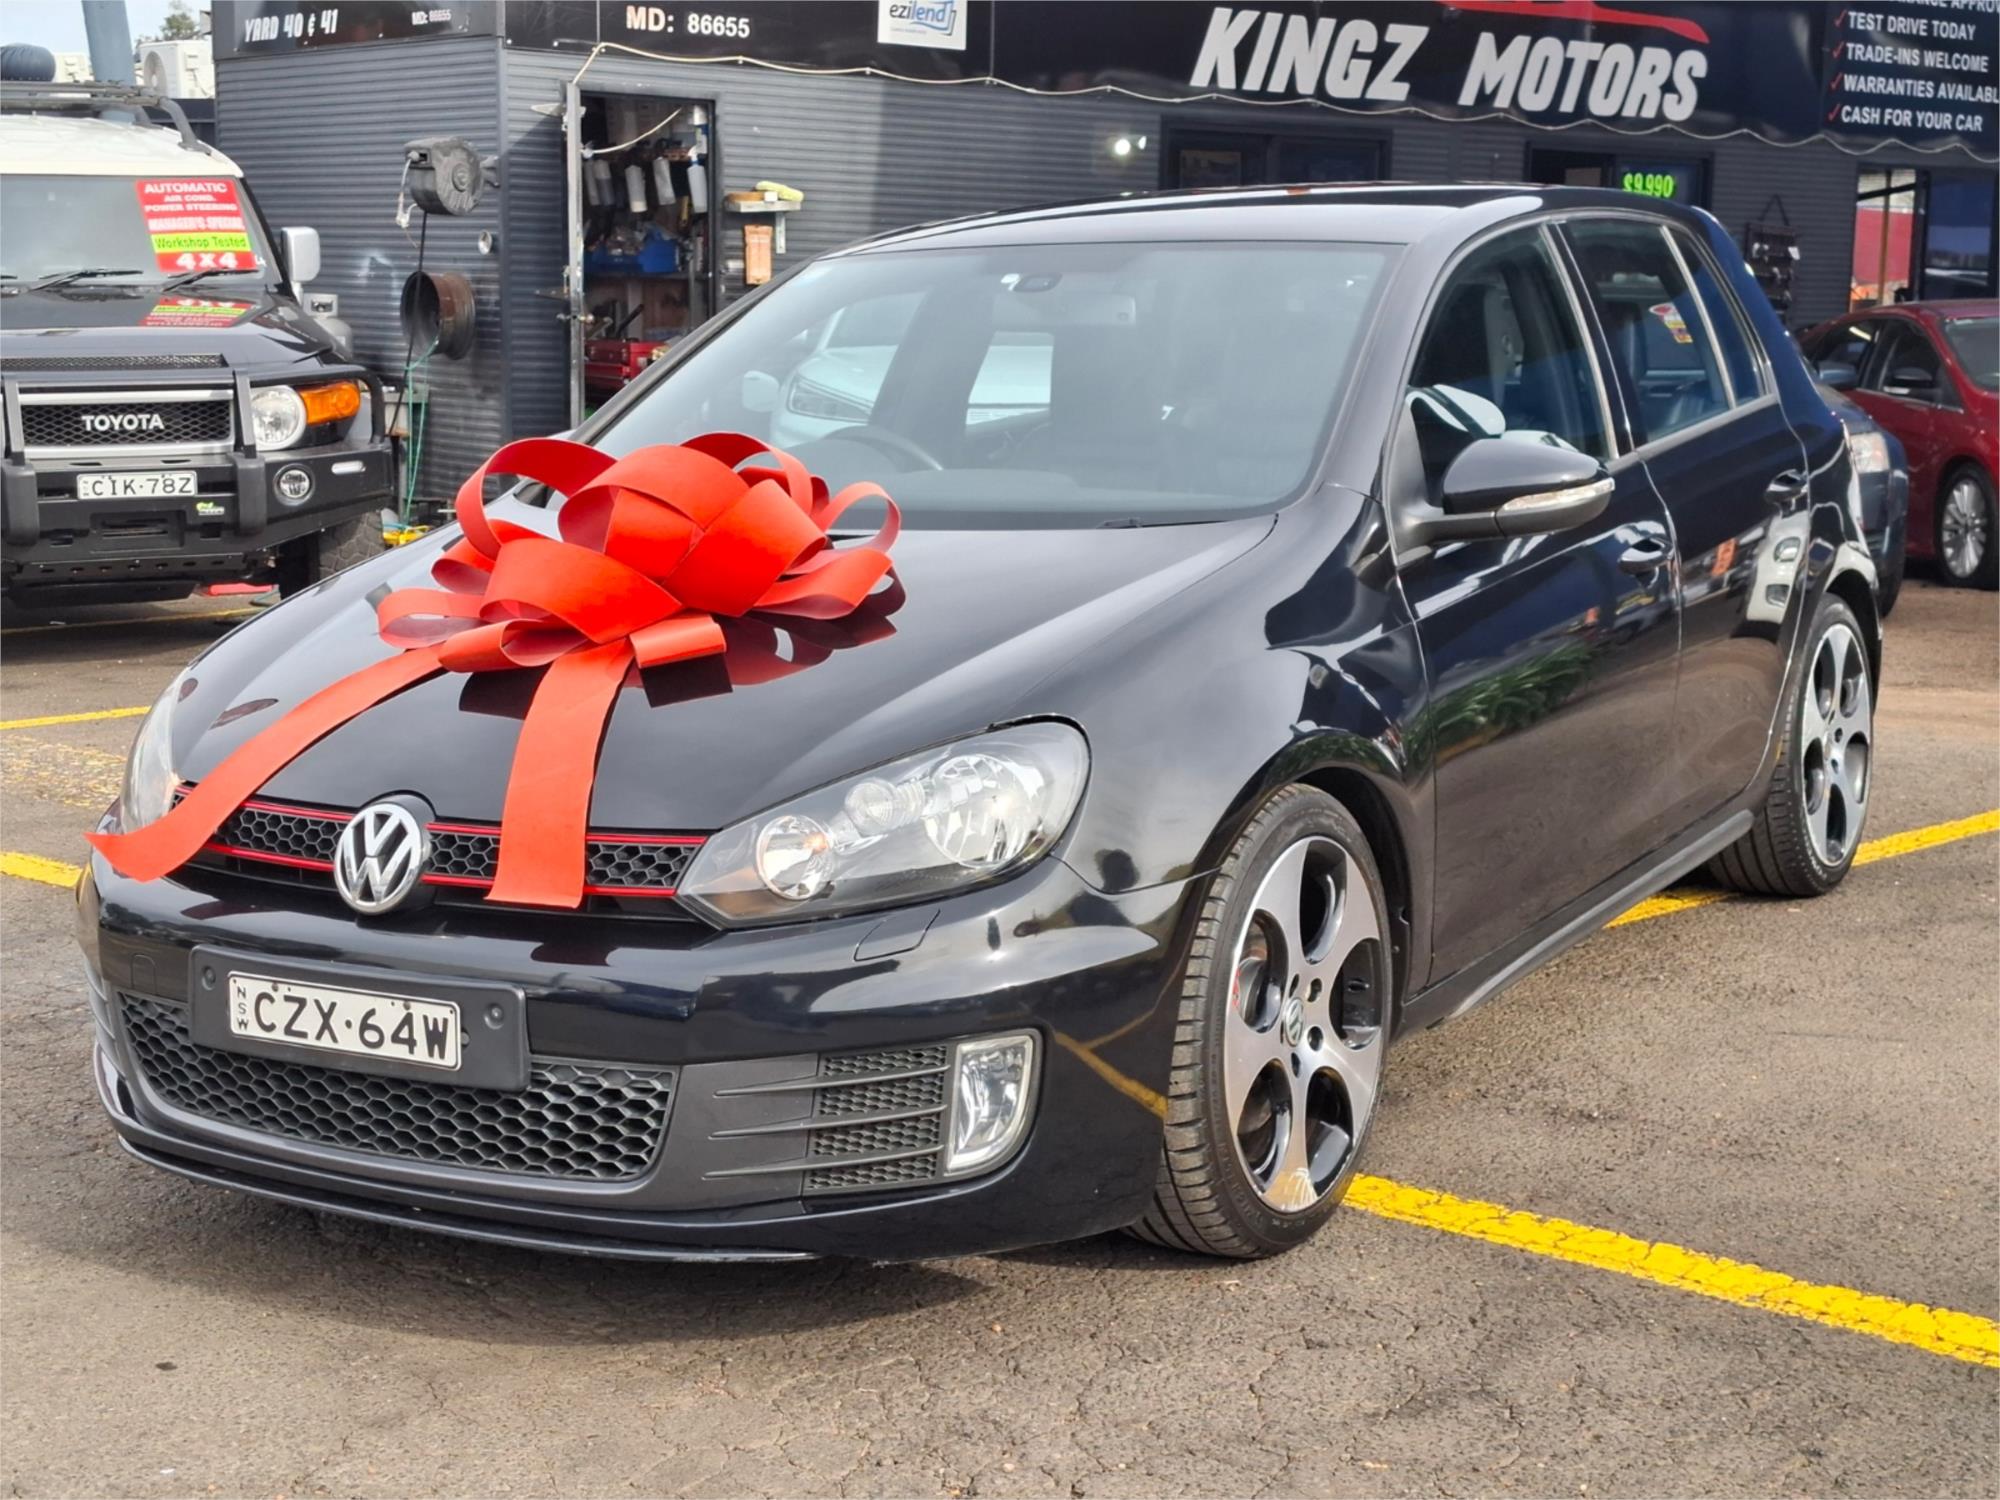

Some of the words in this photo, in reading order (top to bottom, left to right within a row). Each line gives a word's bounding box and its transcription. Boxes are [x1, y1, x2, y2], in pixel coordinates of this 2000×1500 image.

[626, 5, 676, 33] MD:
[687, 13, 751, 38] 86655
[889, 0, 947, 23] ezilend
[244, 16, 279, 42] YARD
[284, 13, 304, 38] 40
[320, 9, 339, 34] 41
[1847, 11, 1884, 31] TEST
[1887, 15, 1928, 36] DRIVE
[1931, 20, 1976, 41] TODAY
[1190, 7, 1430, 101] KINGZ
[1457, 32, 1708, 121] MOTORS
[1846, 43, 1920, 66] TRADE-INS
[1923, 50, 1989, 72] WELCOME
[1843, 74, 1934, 98] WARRANTIES
[1841, 105, 1880, 125] CASH
[1884, 109, 1912, 127] FOR
[1916, 111, 1952, 130] YOUR
[1955, 114, 1983, 132] CAR
[144, 182, 228, 194] AUTOMATIC
[155, 236, 209, 249] Workshop
[212, 235, 247, 248] Tested
[81, 413, 165, 431] TOYOTA
